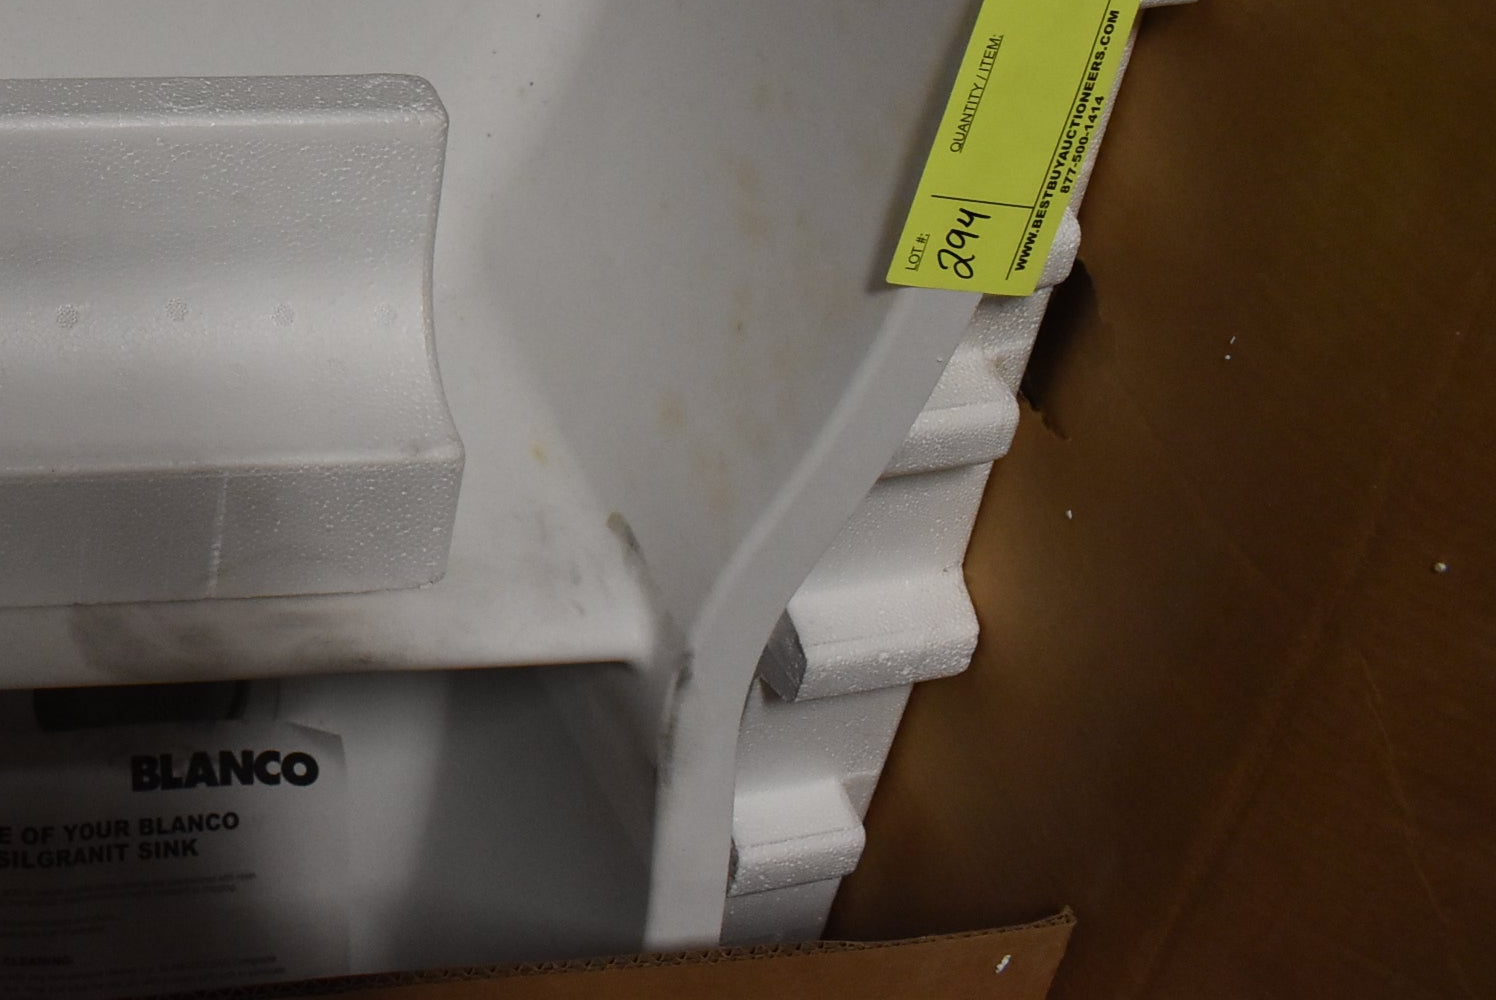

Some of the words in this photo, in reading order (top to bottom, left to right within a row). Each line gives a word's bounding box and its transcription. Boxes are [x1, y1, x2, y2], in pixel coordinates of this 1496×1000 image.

[949, 82, 985, 153] QUANTITY
[979, 34, 1004, 73] ITEM:
[1014, 10, 1120, 271] WWW.BESTBUYAUCTIONEERS.COM
[1060, 95, 1105, 194] 877-500-1414
[905, 246, 922, 271] LOT
[937, 208, 991, 280] 294
[130, 750, 319, 792] BLANCO
[20, 824, 56, 846] OF
[61, 818, 132, 843] YOUR
[137, 811, 240, 837] BLANCO
[136, 837, 200, 861] SINK
